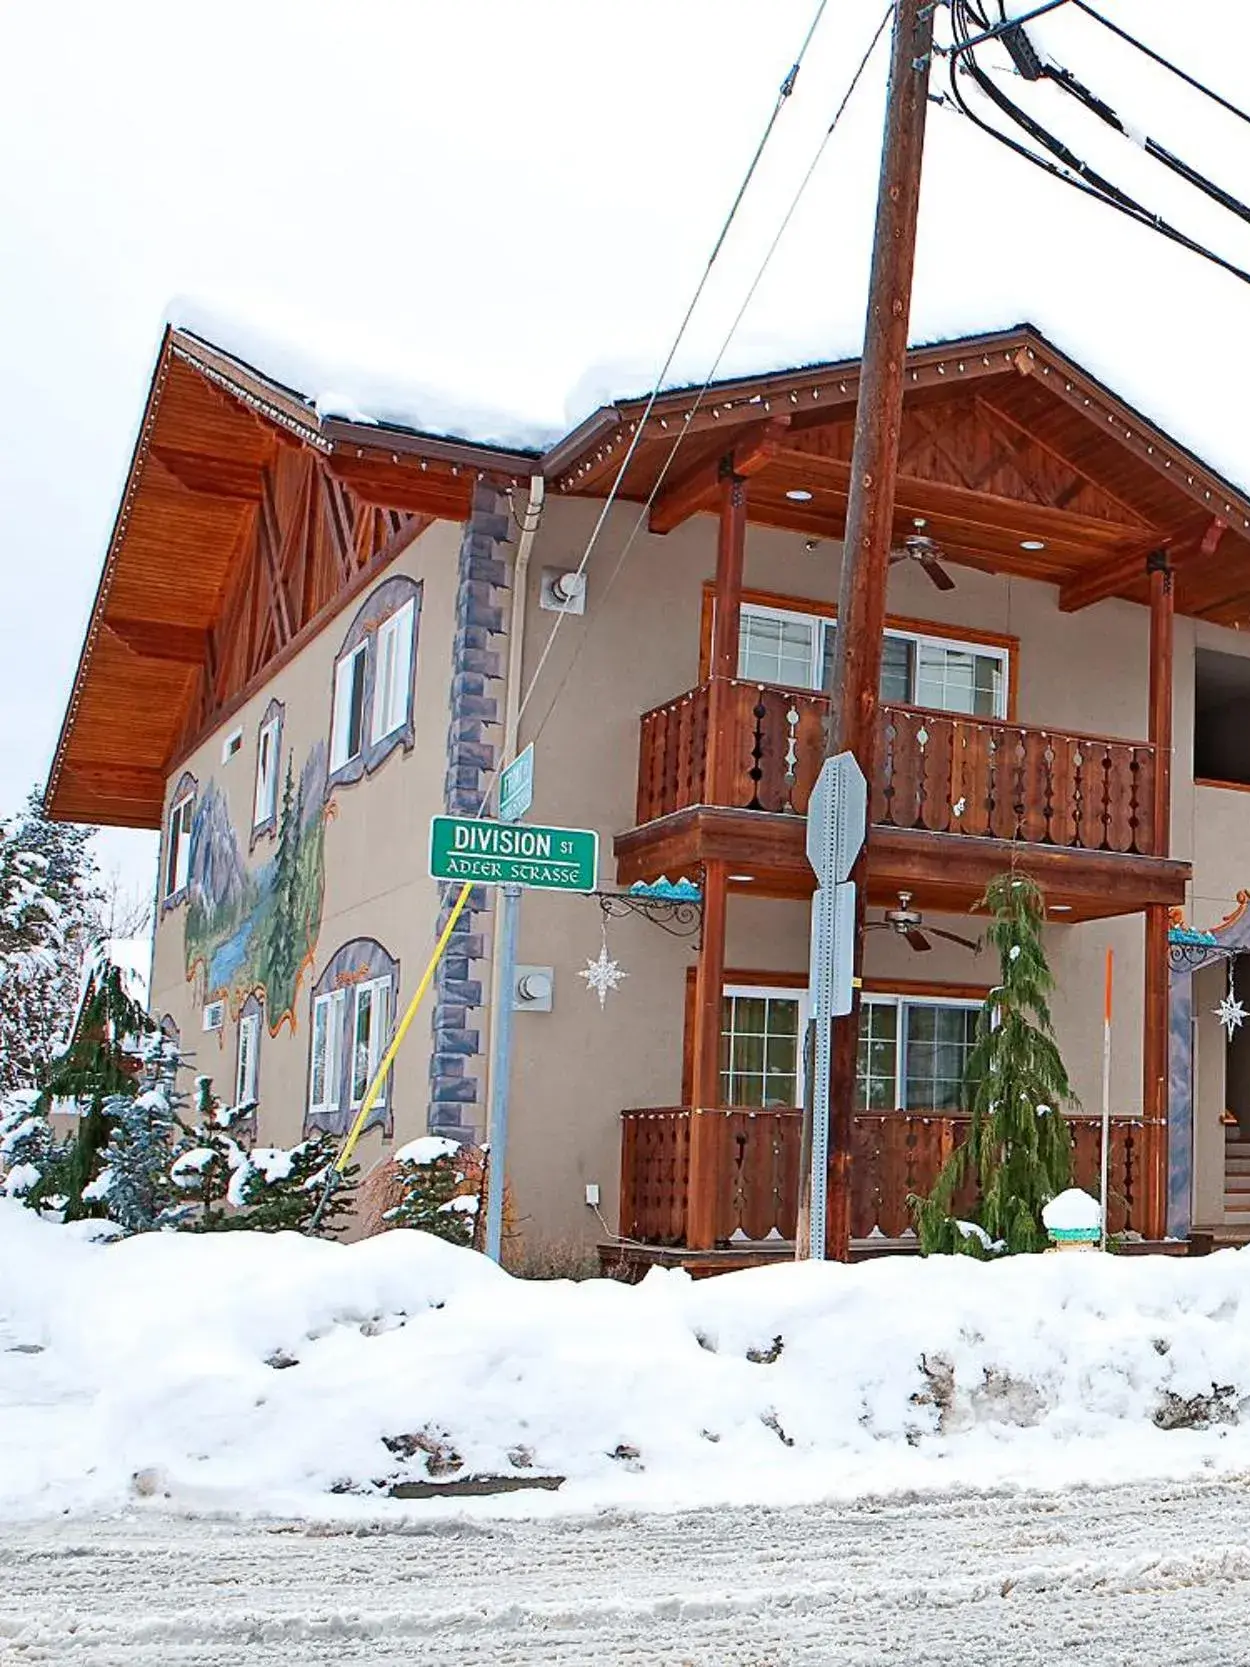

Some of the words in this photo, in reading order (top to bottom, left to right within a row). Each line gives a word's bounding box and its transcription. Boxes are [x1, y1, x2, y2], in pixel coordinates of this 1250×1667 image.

[455, 826, 551, 857] DIVISION
[560, 841, 574, 854] ST
[447, 858, 502, 877] ADLER
[511, 864, 580, 883] STRASSE
